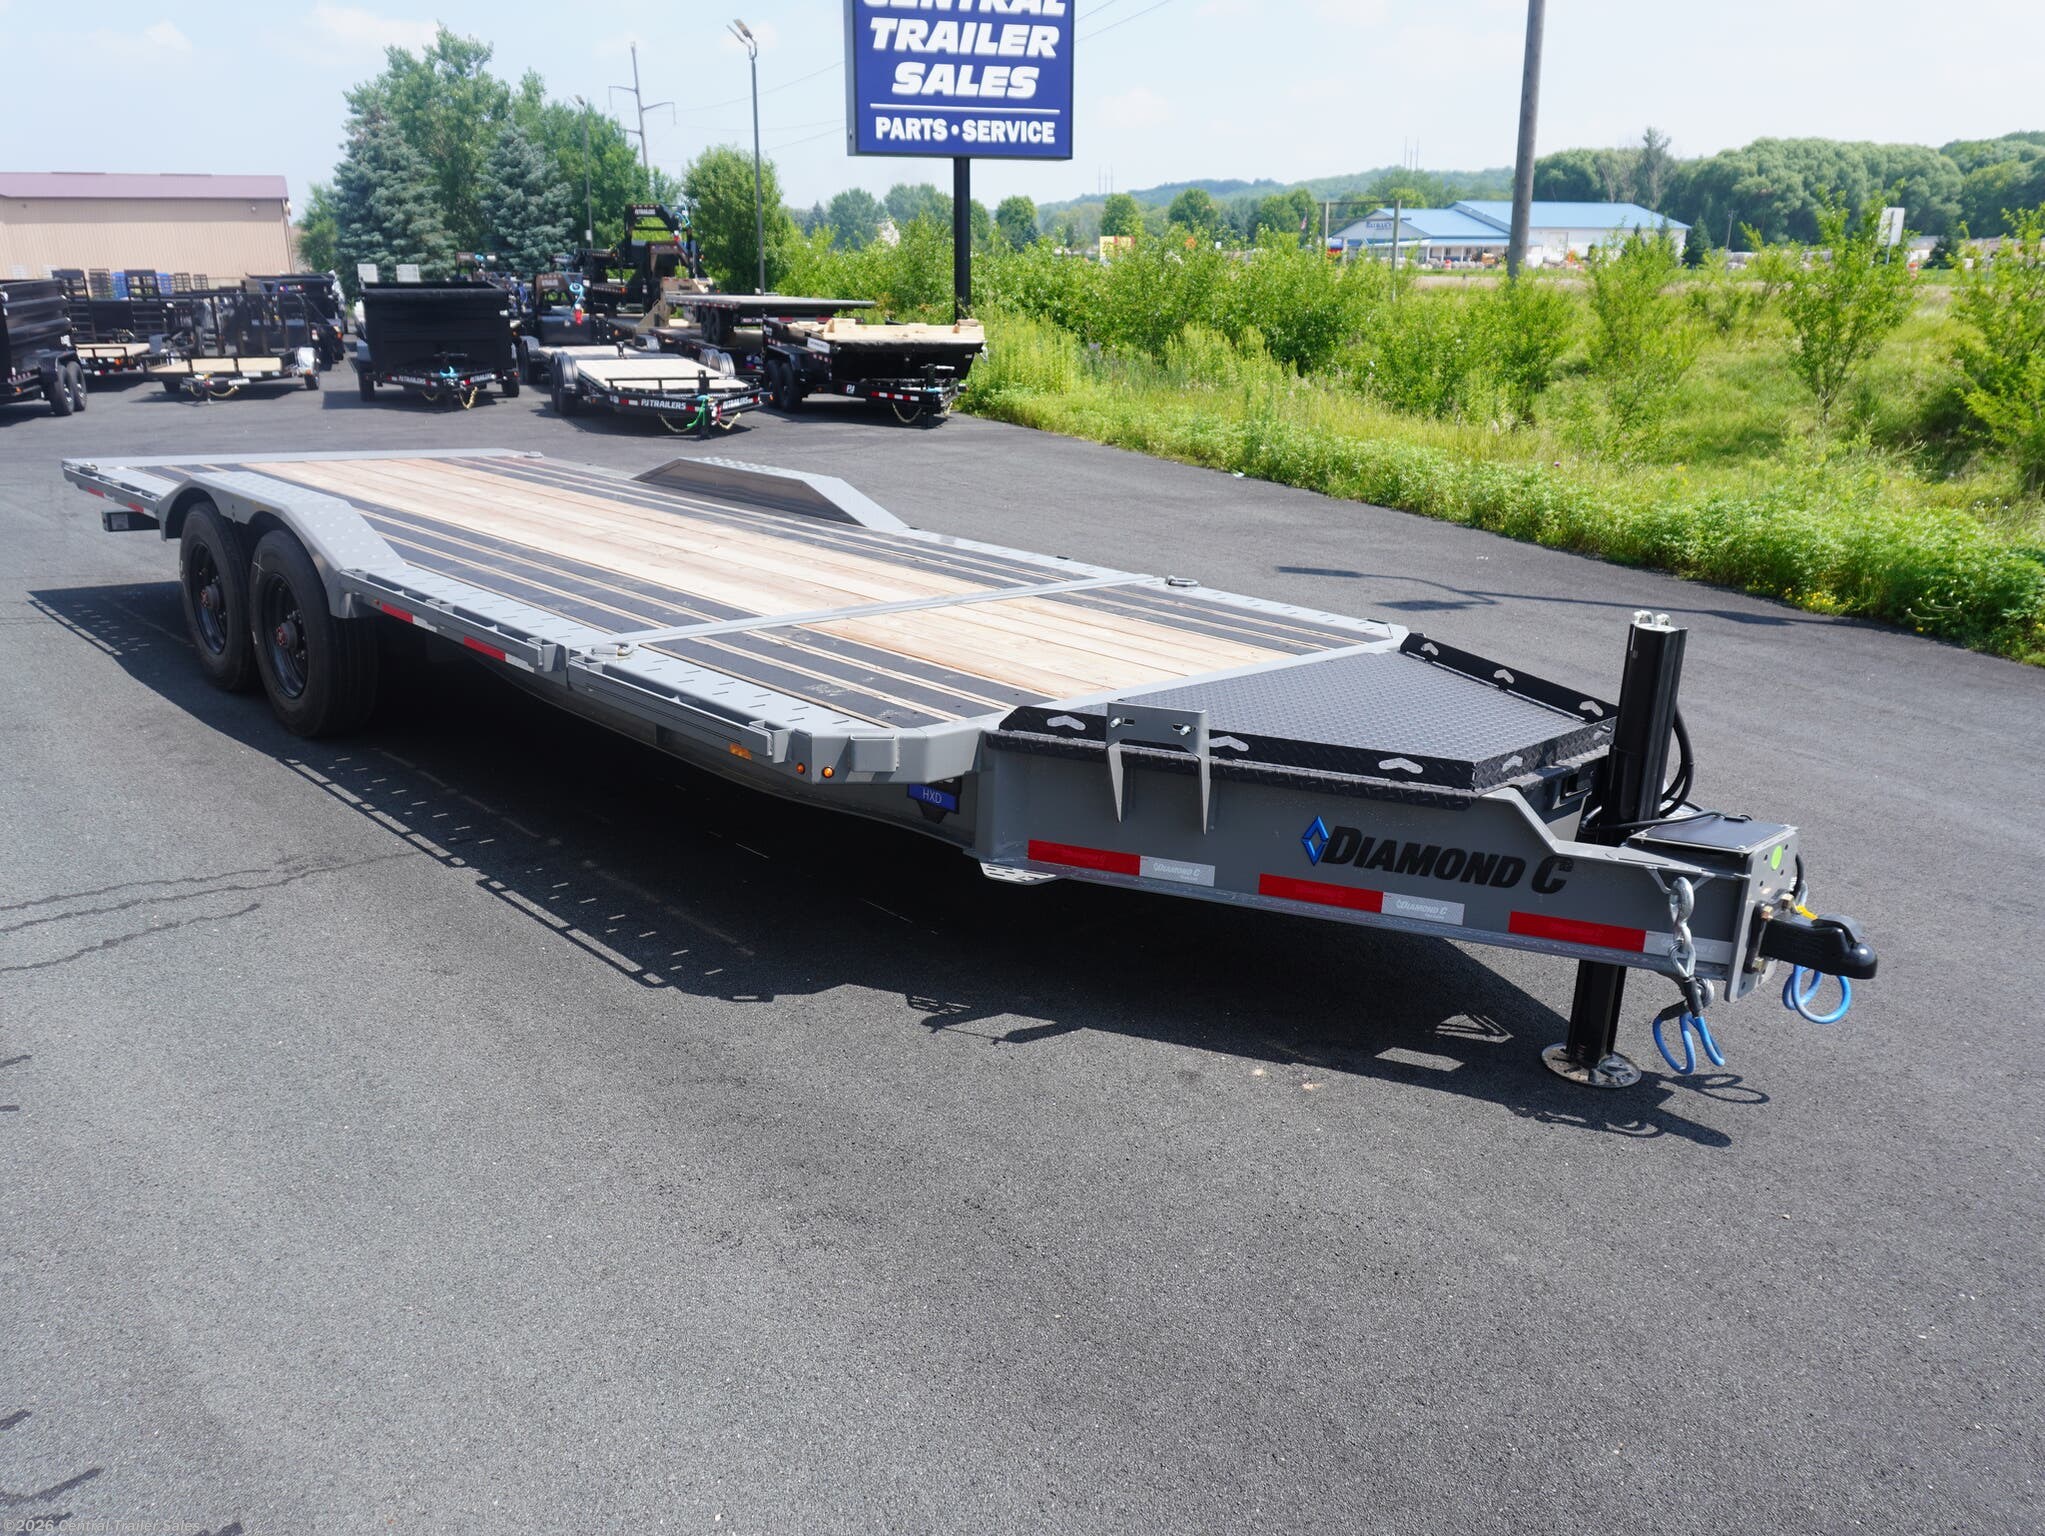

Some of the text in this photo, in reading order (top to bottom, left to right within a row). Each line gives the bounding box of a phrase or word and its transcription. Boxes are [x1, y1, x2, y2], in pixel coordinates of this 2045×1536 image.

[870, 17, 1060, 58] TRAILER
[892, 62, 1040, 100] SALES
[875, 116, 1056, 144] PARTS SERVICE
[922, 788, 942, 804] HXD
[1321, 825, 1574, 894] DIAMOND C
